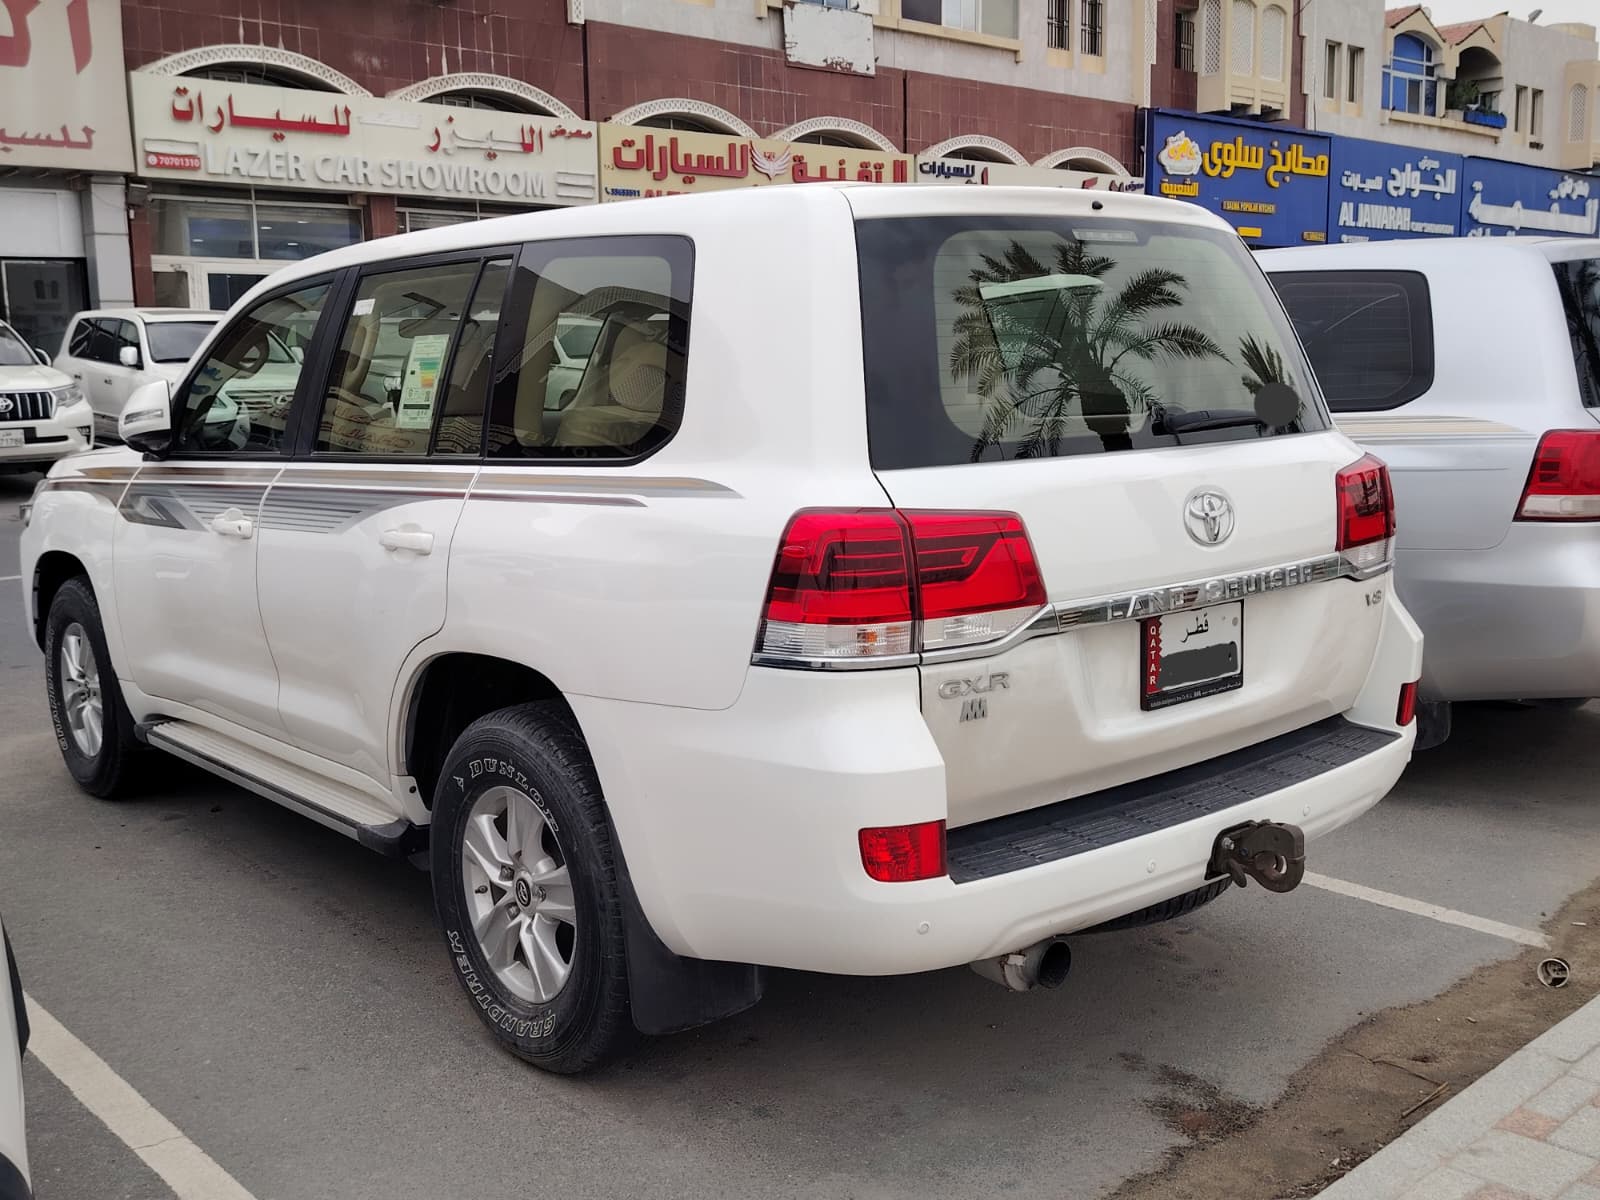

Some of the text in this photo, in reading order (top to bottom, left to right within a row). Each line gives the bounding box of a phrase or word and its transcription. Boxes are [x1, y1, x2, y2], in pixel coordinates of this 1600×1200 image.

[172, 86, 351, 143] للسيارات
[205, 144, 547, 198] LAZER CAR SHOWROOM
[612, 134, 749, 184] للسيارات
[1202, 136, 1265, 179] سلوى
[1265, 140, 1329, 188] مطابخ
[1338, 202, 1356, 227] AL
[1106, 562, 1314, 621] LAND CRUISER
[1181, 612, 1209, 643] قطر
[1150, 626, 1158, 686] QATAR
[938, 672, 1010, 700] GXR
[469, 758, 559, 832] DUNLOP
[446, 929, 556, 1038] GRANDTREK
